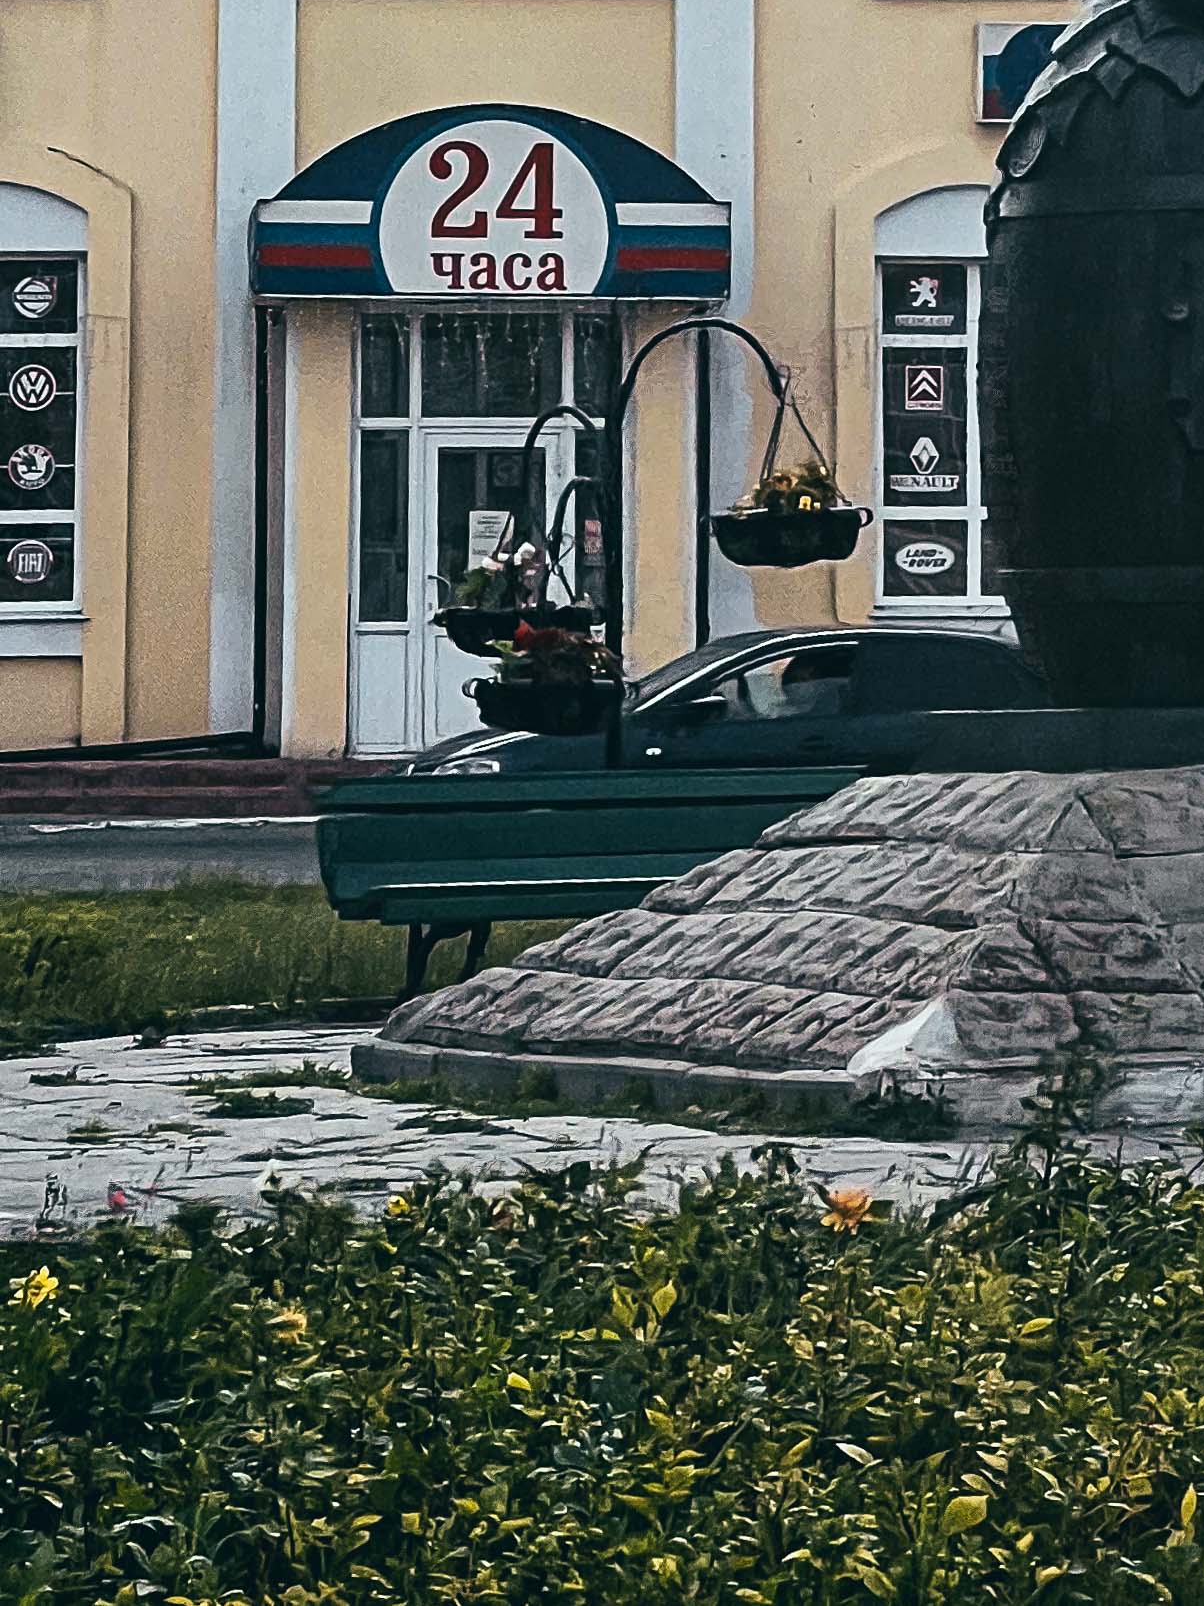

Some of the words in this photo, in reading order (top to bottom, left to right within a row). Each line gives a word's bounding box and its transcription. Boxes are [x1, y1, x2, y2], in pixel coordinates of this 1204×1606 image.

[429, 140, 564, 240] 24
[431, 252, 567, 292] часа
[18, 553, 44, 573] FIAT
